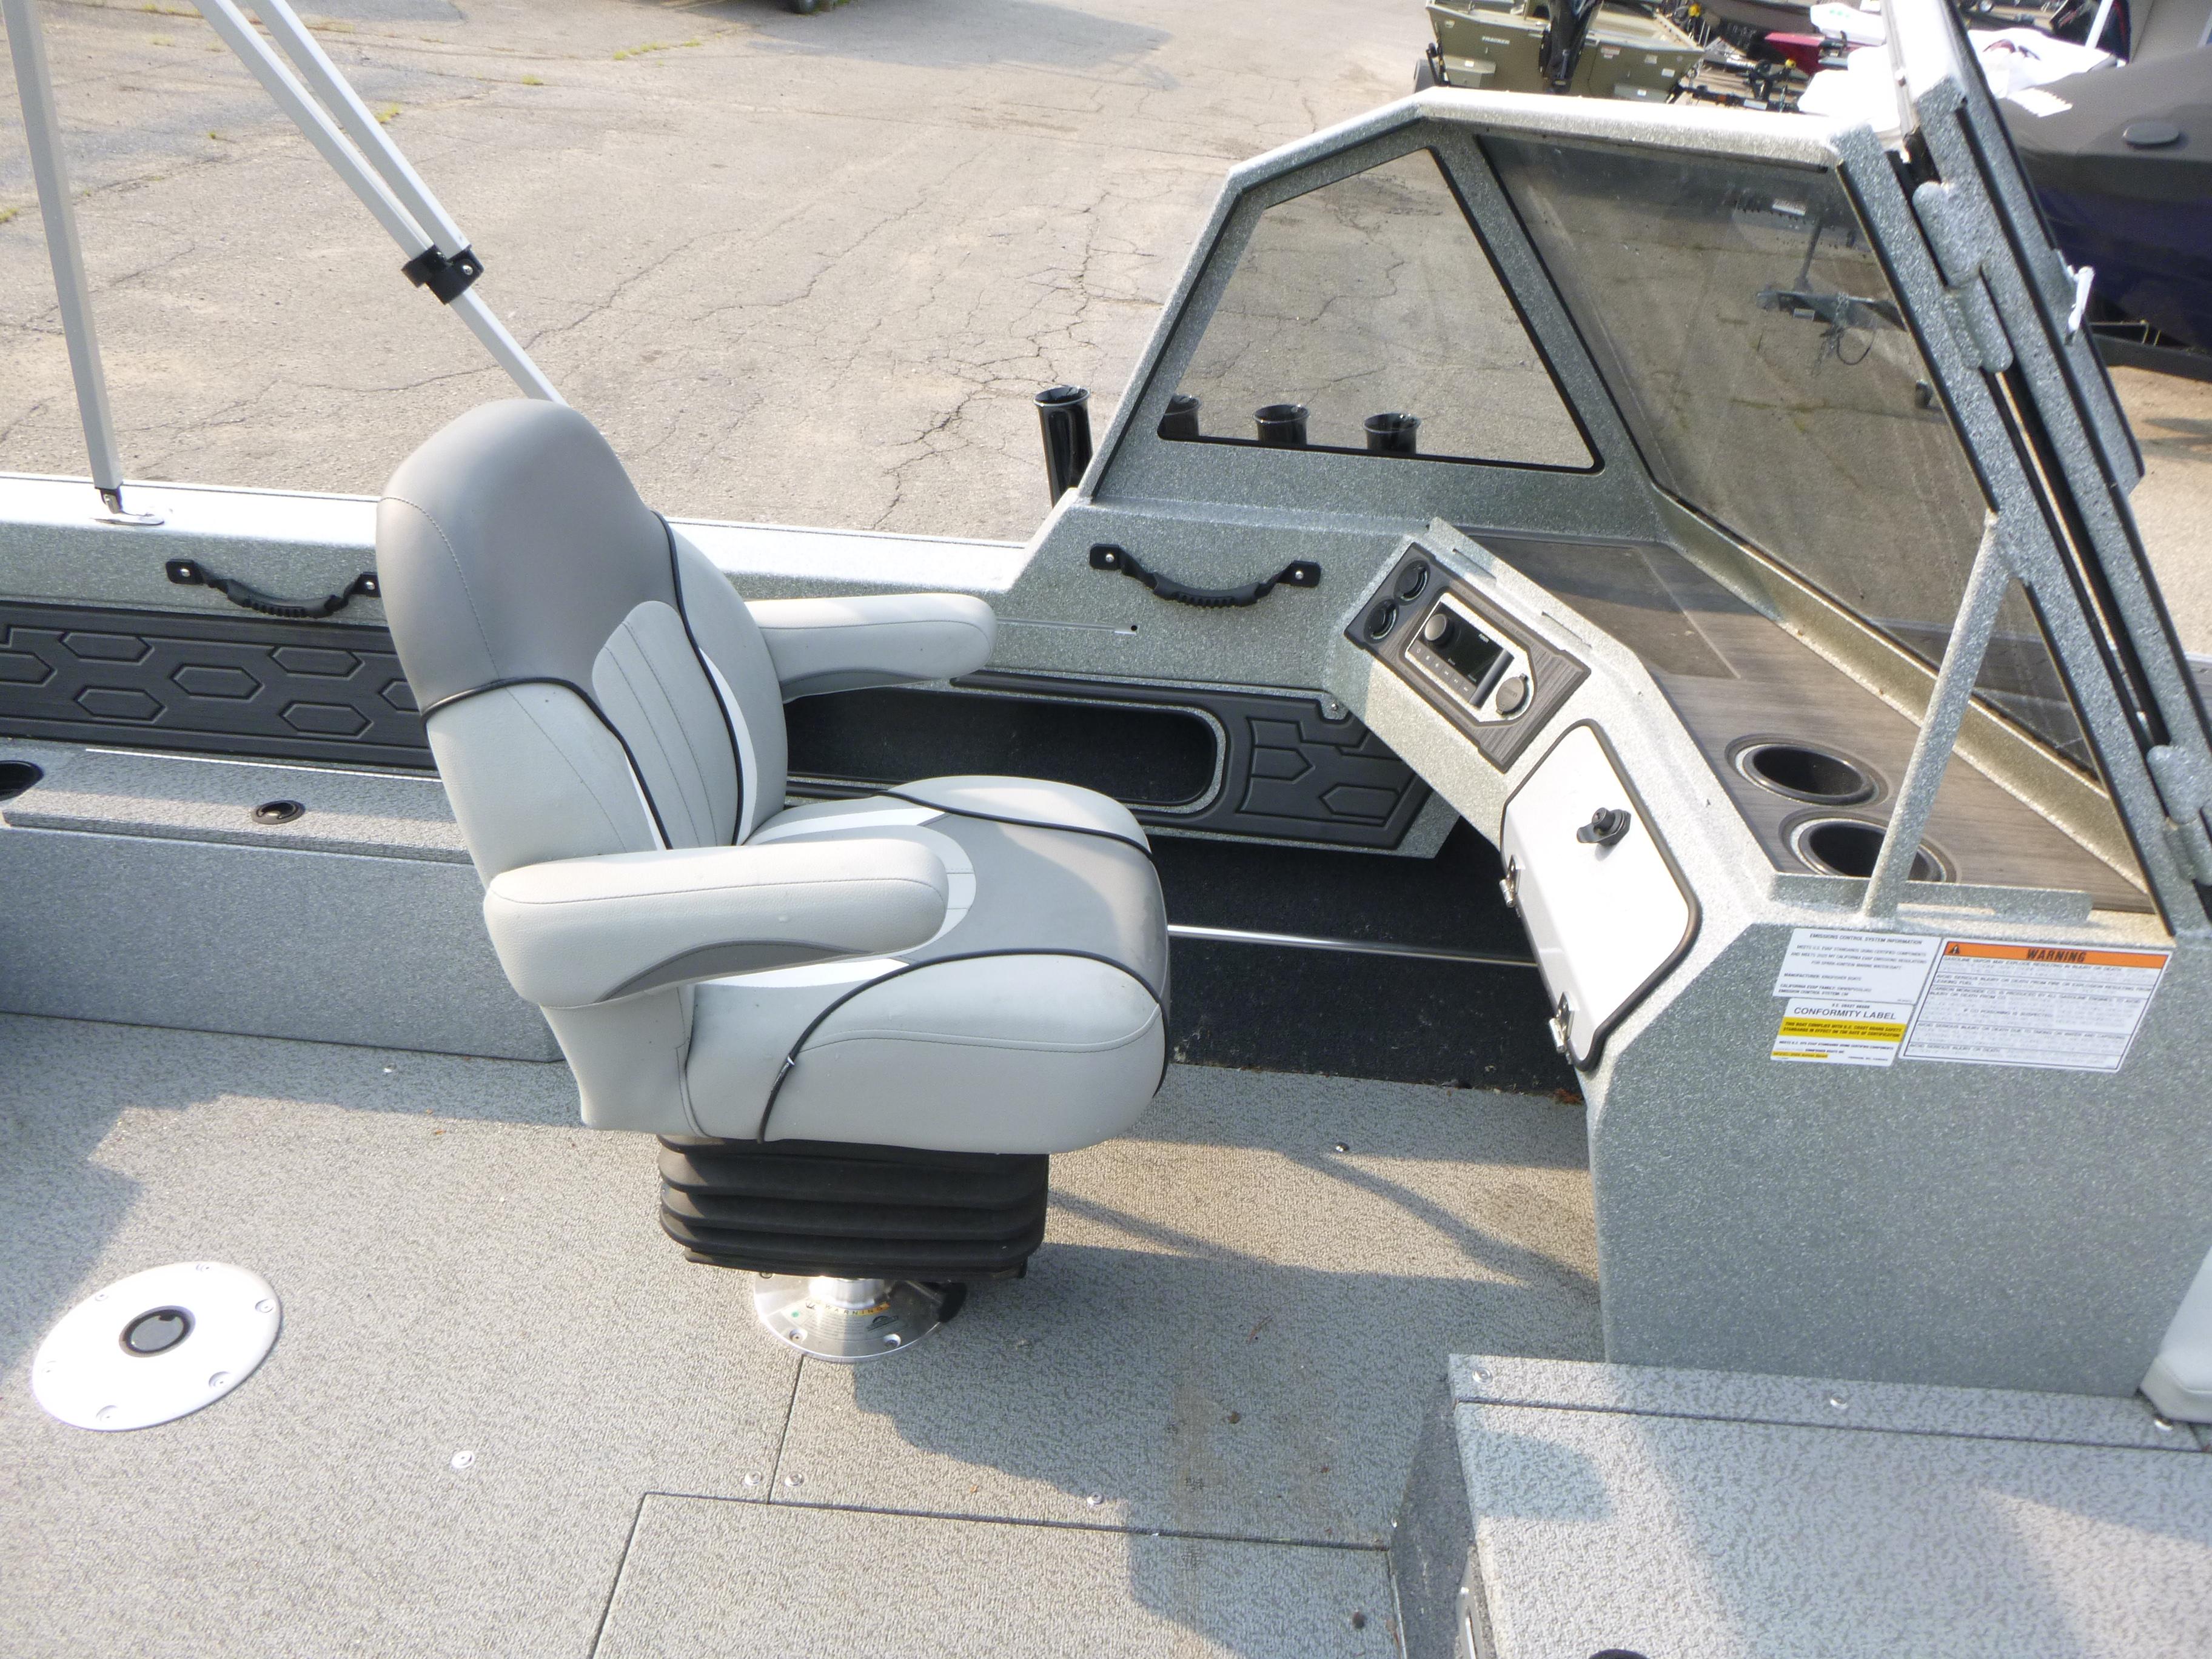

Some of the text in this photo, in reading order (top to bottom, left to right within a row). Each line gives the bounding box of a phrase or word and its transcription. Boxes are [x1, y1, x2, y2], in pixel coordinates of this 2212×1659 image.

[1481, 36, 1510, 45] TRACKER
[2025, 948, 2087, 962] WARNING
[1793, 1006, 1897, 1020] CONFORMITY LABEL
[825, 1304, 883, 1315] WARNING
